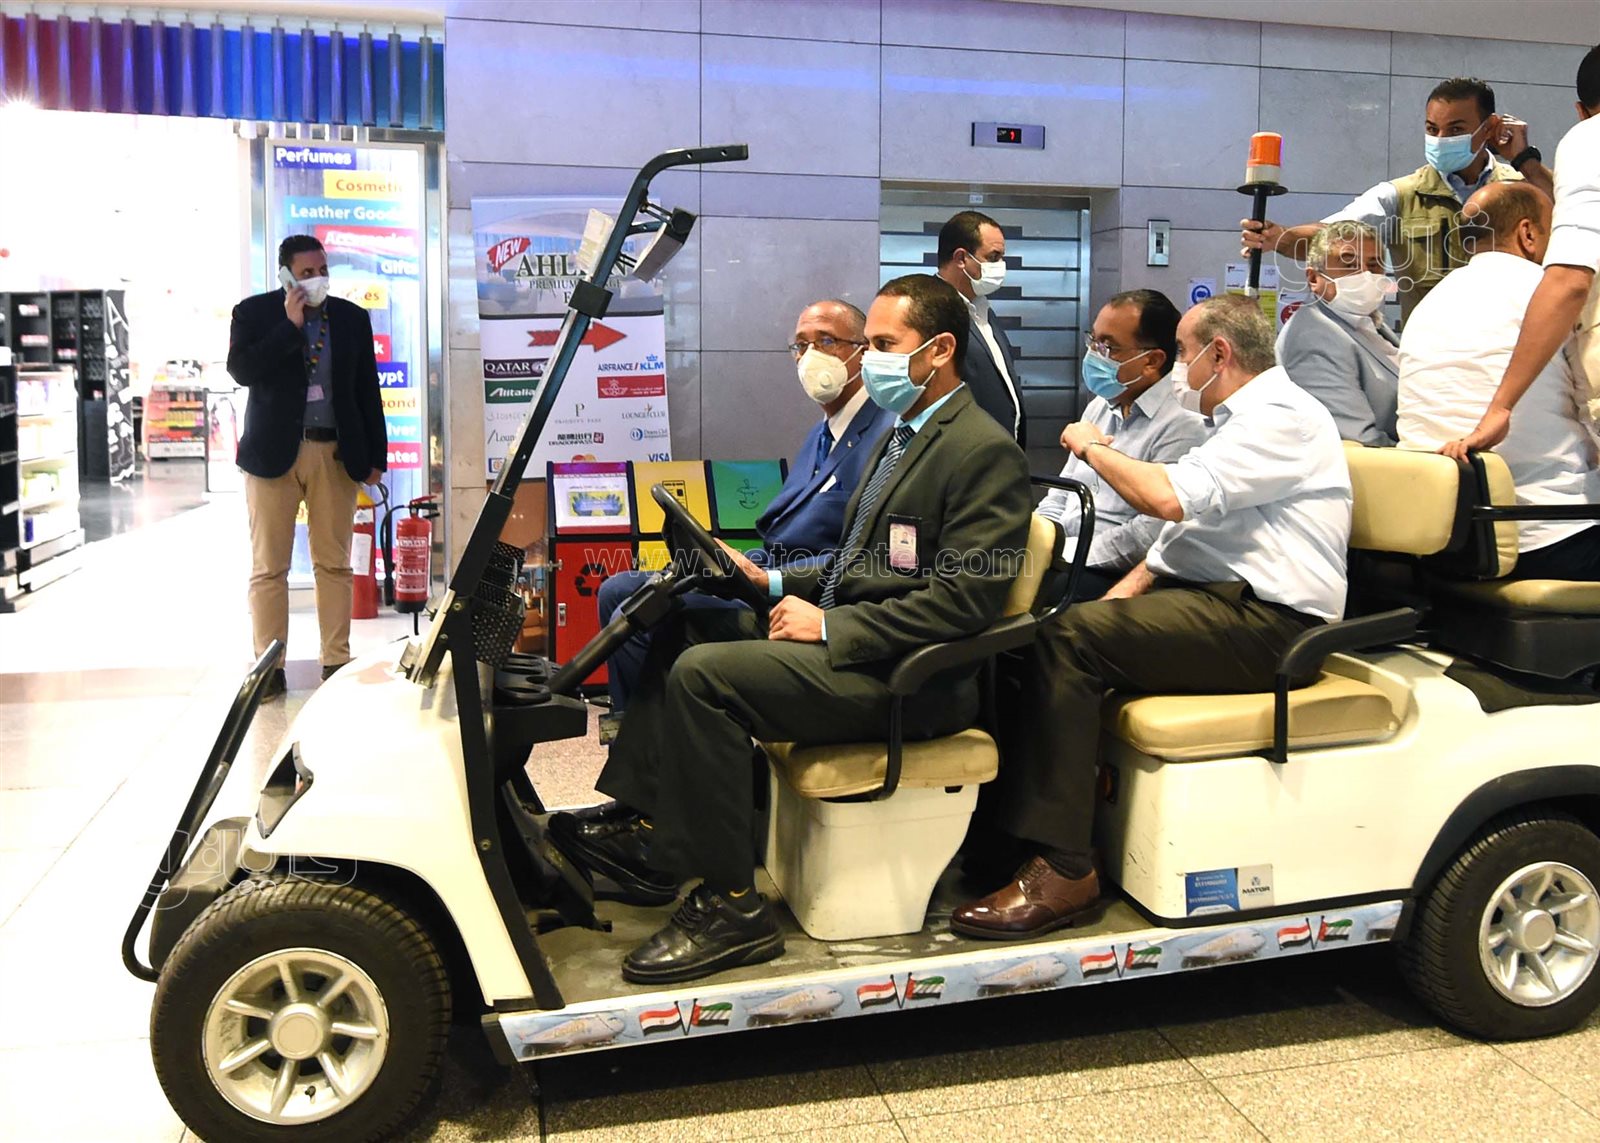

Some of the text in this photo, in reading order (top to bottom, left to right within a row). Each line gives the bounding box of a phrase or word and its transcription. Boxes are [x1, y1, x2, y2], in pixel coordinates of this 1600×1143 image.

[276, 148, 352, 165] Perfumes
[290, 204, 350, 219] Leather
[495, 238, 522, 268] NEW
[485, 362, 531, 373] QATAR
[640, 362, 664, 370] KLM
[489, 387, 535, 397] Alitalia
[648, 453, 670, 463] VISA
